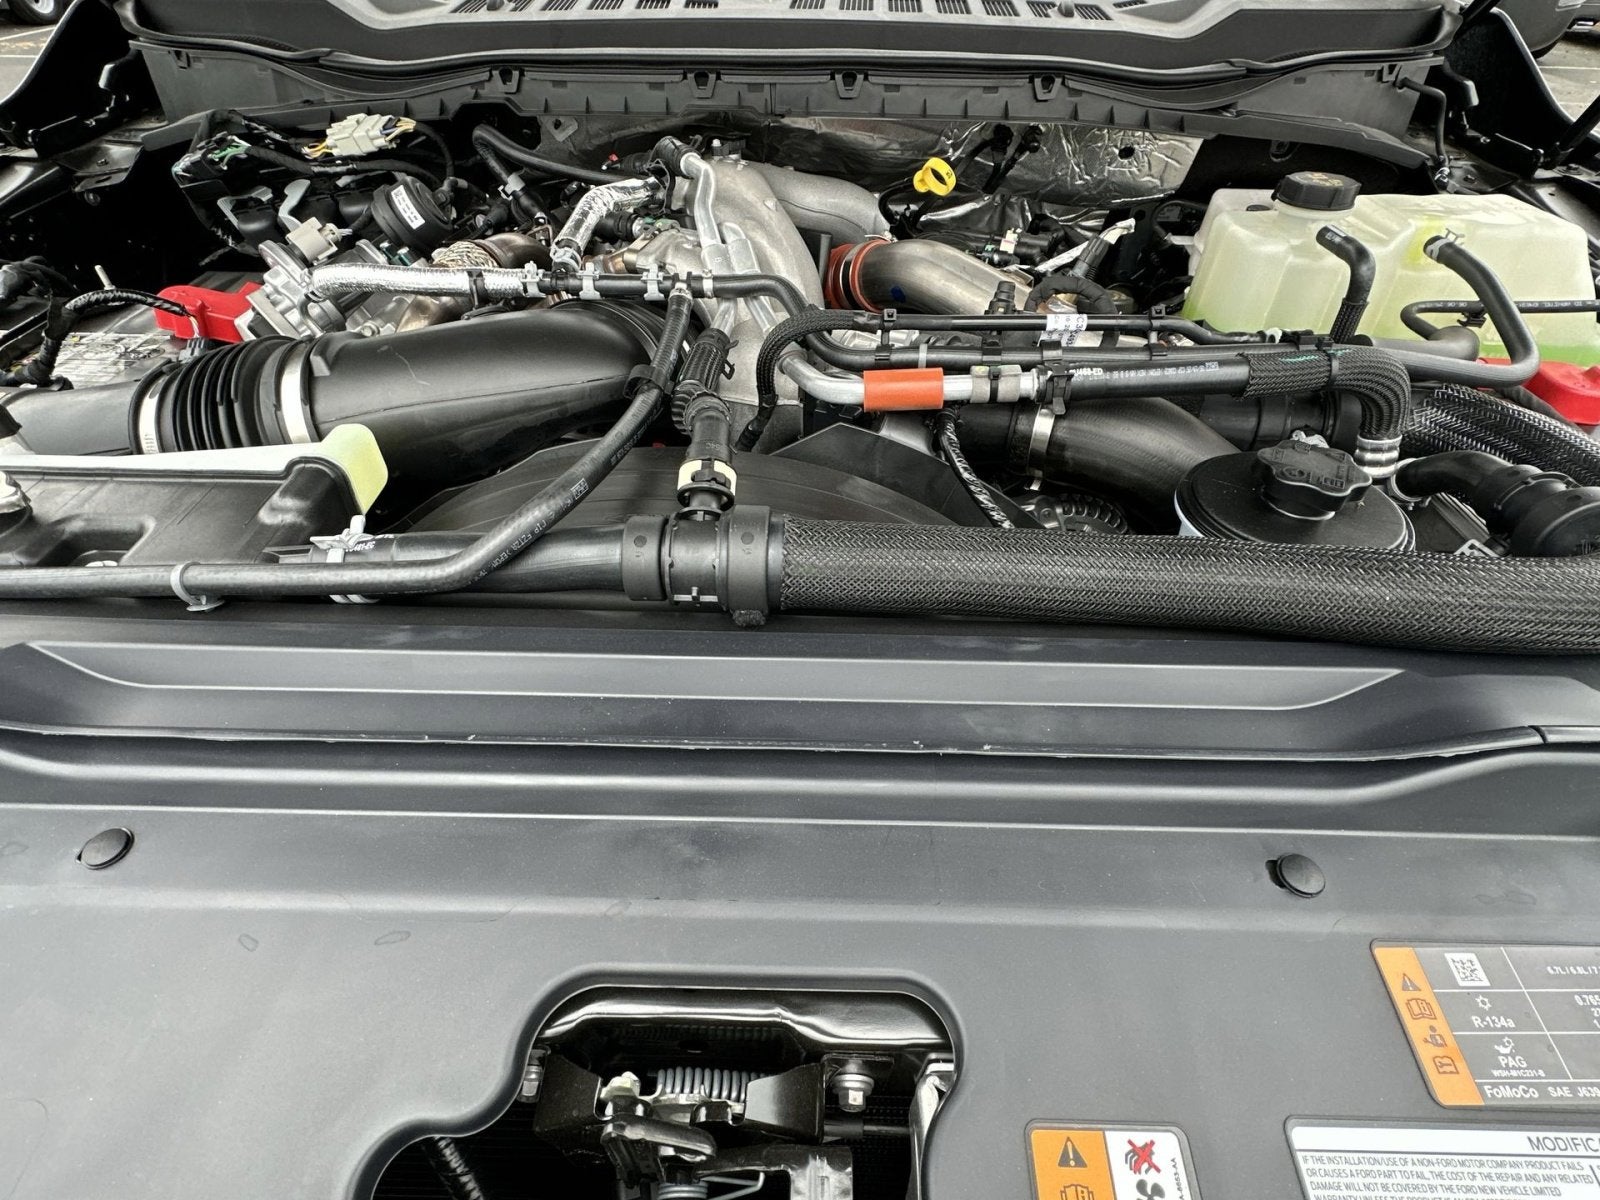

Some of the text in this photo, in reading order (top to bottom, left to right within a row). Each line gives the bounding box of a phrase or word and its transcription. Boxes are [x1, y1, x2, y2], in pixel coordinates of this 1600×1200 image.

[1471, 1015, 1516, 1029] R-134a
[1497, 1055, 1528, 1068] PAG
[1483, 1085, 1539, 1098] FoMoCo
[1547, 1086, 1573, 1098] SAE
[1526, 1136, 1600, 1152] MODIFIC
[1302, 1156, 1309, 1164] IF
[1310, 1156, 1326, 1165] THE
[1399, 1158, 1408, 1166] OF
[1411, 1158, 1417, 1166] A
[1418, 1158, 1457, 1168] NON-FORD
[1458, 1159, 1486, 1168] MOTOR
[1486, 1160, 1523, 1169] COMPANY
[1524, 1160, 1562, 1170] PRODUCT
[1561, 1161, 1584, 1170] FAILS
[1306, 1168, 1318, 1178] OR
[1318, 1168, 1348, 1178] CAUSES
[1350, 1169, 1356, 1178] A
[1356, 1169, 1377, 1178] FORD
[1378, 1170, 1398, 1179] PART
[1398, 1170, 1410, 1180] TO
[1430, 1171, 1446, 1180] THE
[1446, 1172, 1467, 1181] COST
[1467, 1172, 1477, 1182] OF
[1479, 1172, 1495, 1182] THE
[1496, 1173, 1523, 1182] REPAIR
[1525, 1174, 1541, 1183] AND
[1542, 1174, 1558, 1183] ANY
[1559, 1174, 1594, 1184] RELATED
[1310, 1181, 1562, 1196] DAMAGE WILL NOT BE COVERED BY THE FORD NEW VEHICLE LIMITED
